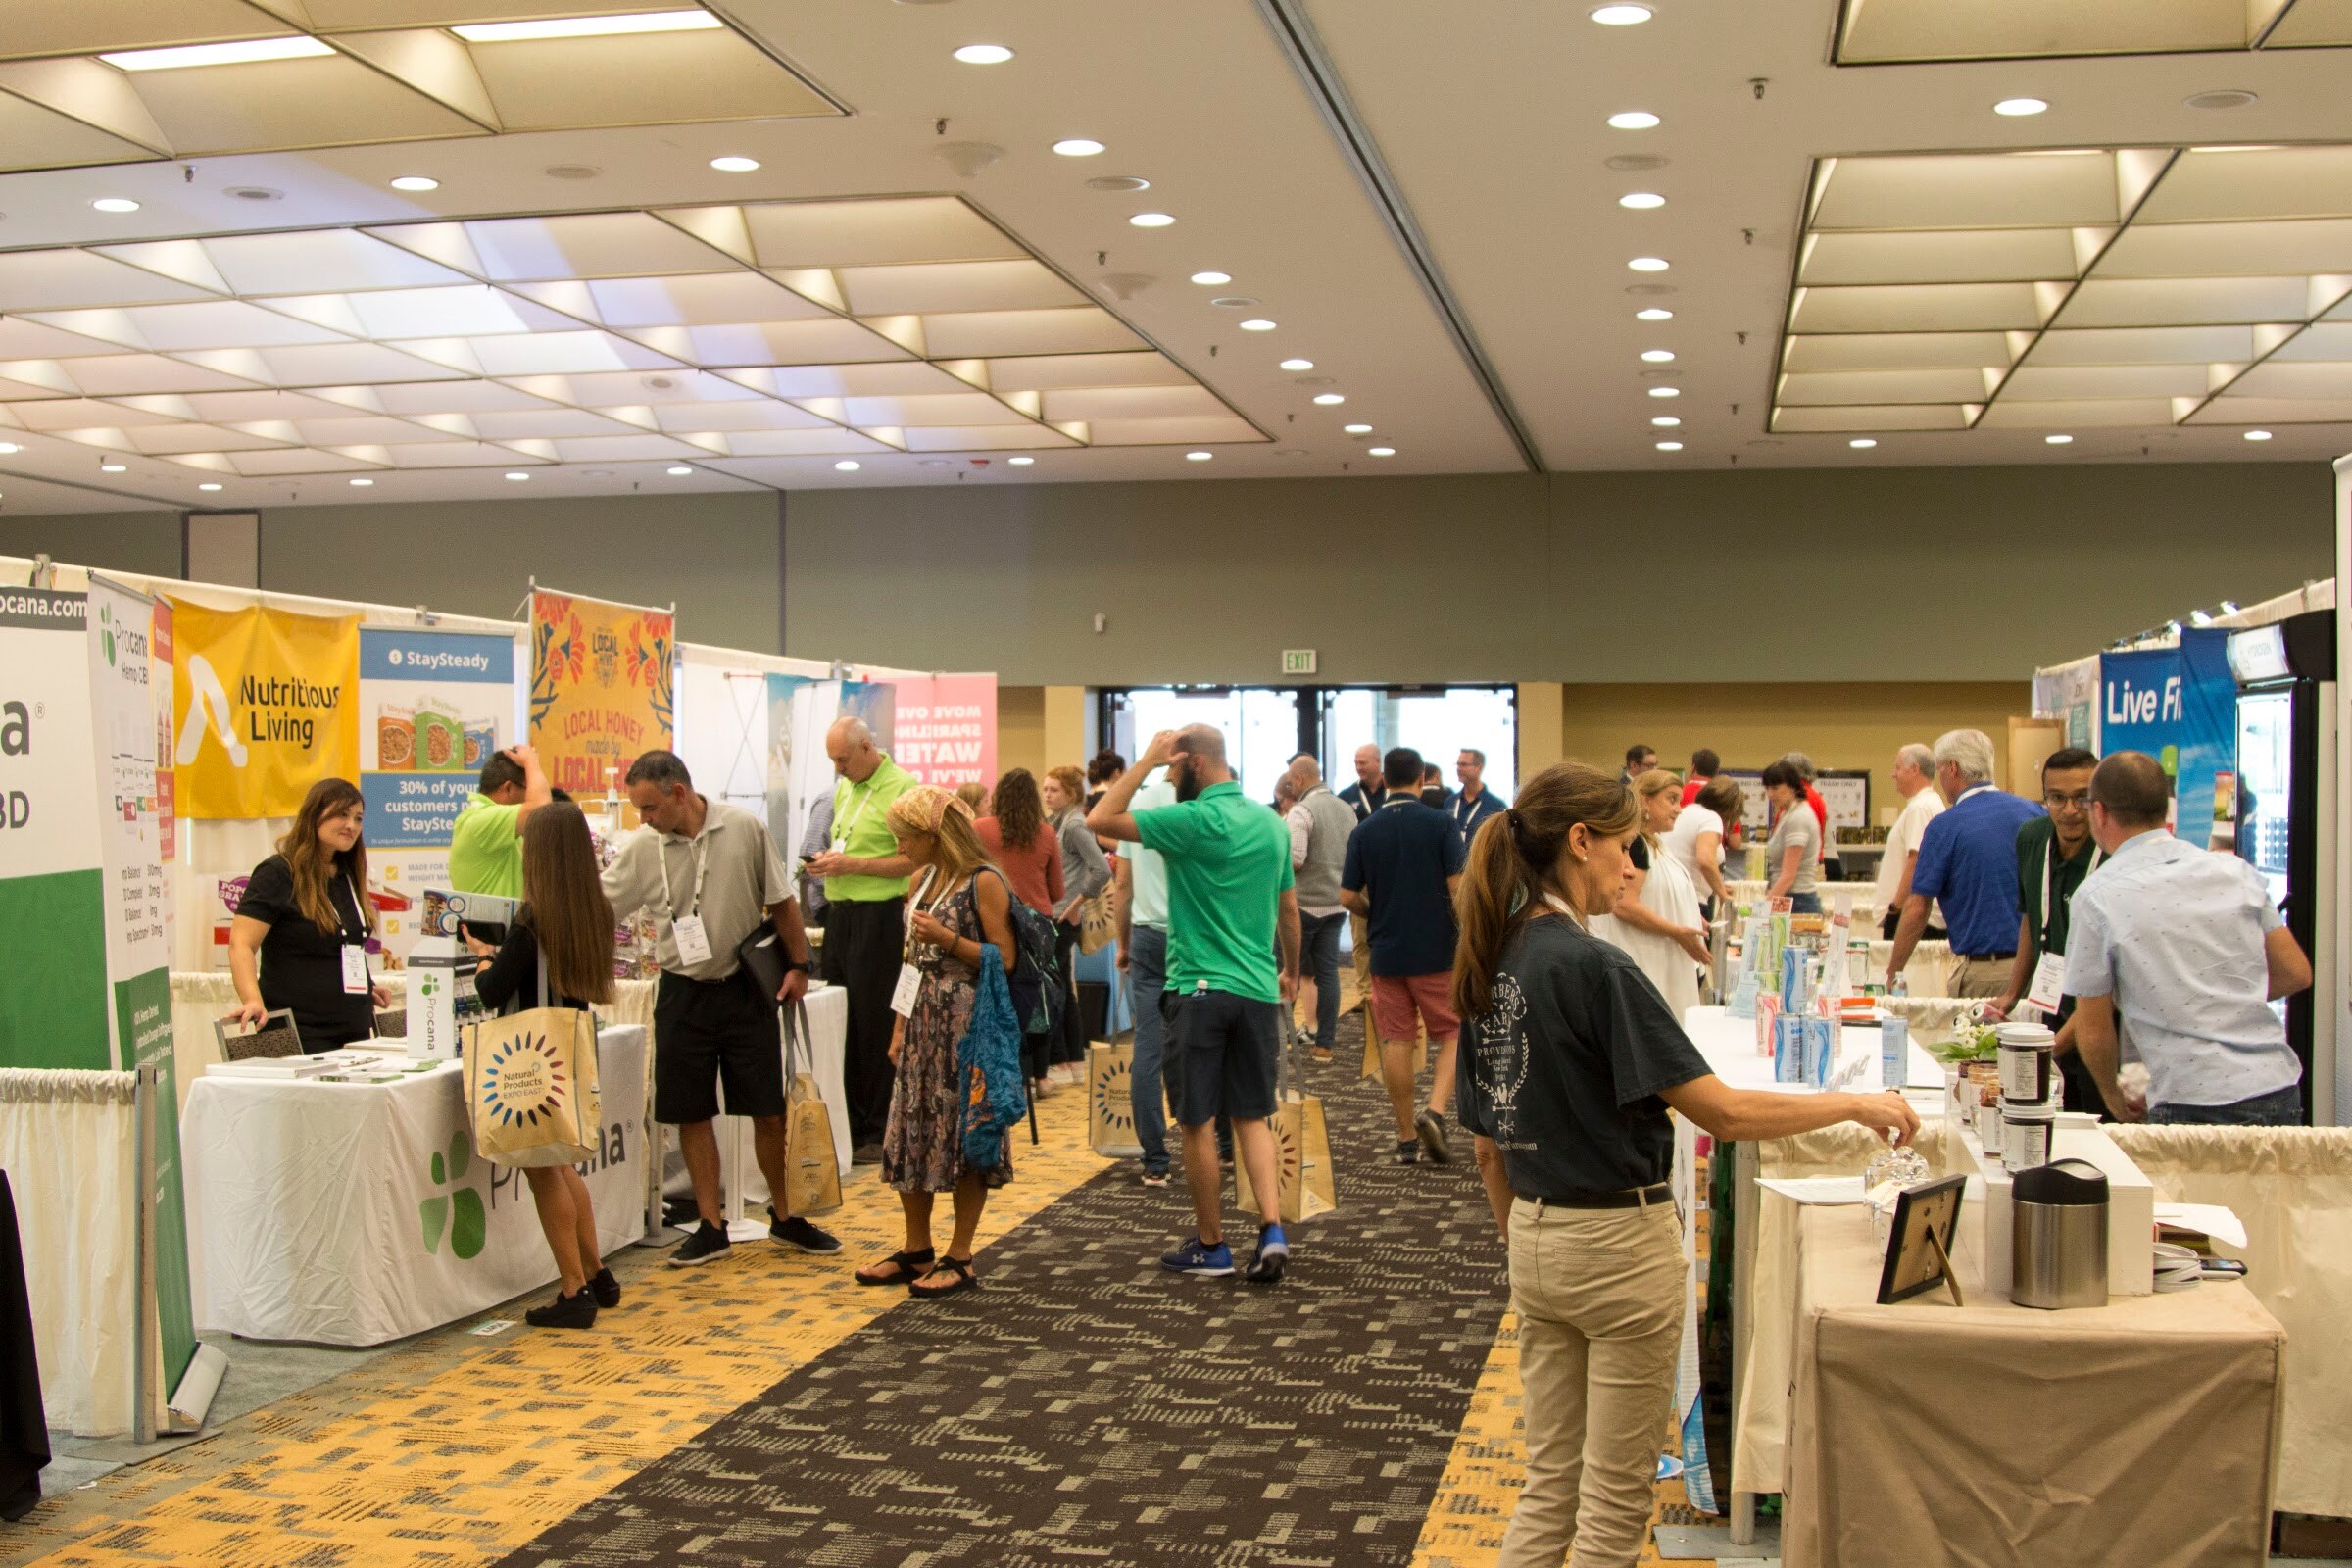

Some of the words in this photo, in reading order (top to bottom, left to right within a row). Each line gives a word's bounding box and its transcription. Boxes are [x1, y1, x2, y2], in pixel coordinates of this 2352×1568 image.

[407, 651, 489, 670] StaySteady
[1287, 652, 1311, 670] EXIT
[240, 673, 340, 710] Nutritious
[2107, 680, 2157, 724] Live
[250, 710, 314, 751] Living
[564, 709, 601, 740] LOCAL
[605, 710, 644, 745] HONEY
[553, 754, 608, 793] LOCAL
[399, 780, 428, 795] 30%
[431, 780, 447, 795] of
[448, 783, 479, 798] your
[385, 801, 458, 813] customers
[402, 816, 454, 834] StaySte
[426, 998, 437, 1051] Procana
[504, 1068, 535, 1081] Natural
[504, 1078, 543, 1090] Products
[504, 1090, 522, 1099] EXPO
